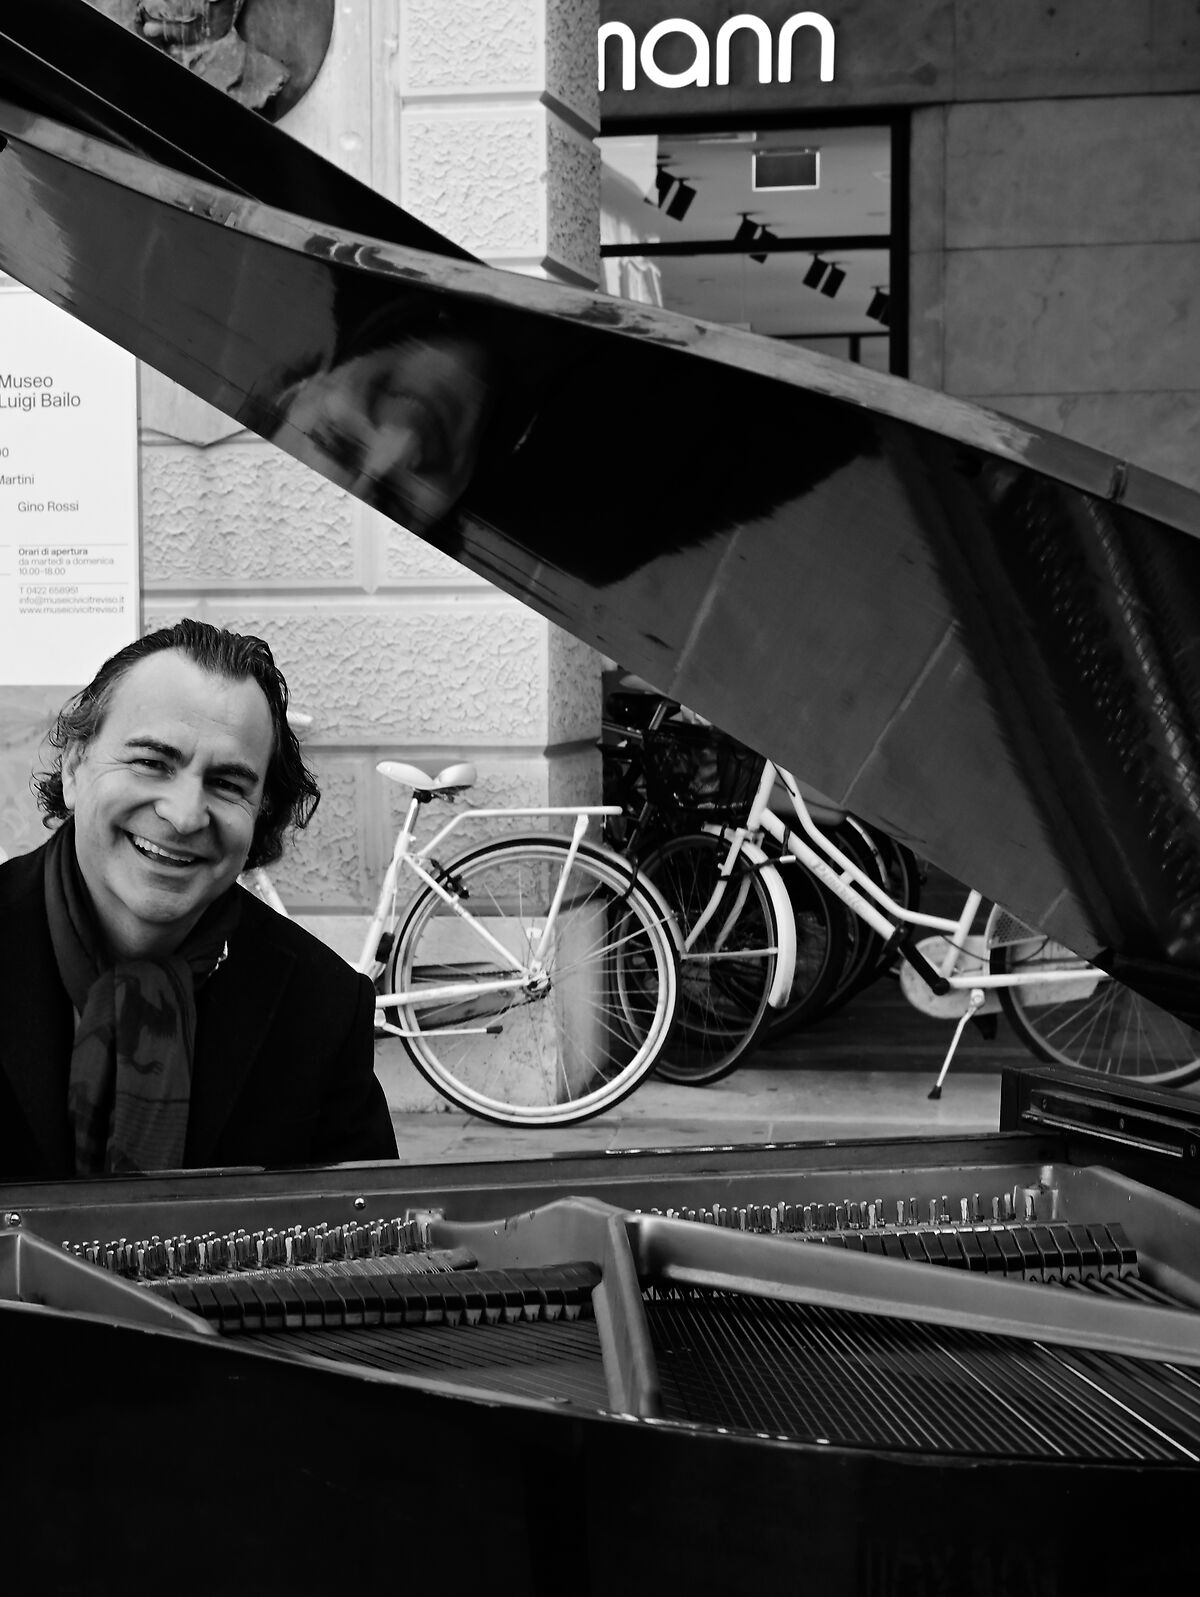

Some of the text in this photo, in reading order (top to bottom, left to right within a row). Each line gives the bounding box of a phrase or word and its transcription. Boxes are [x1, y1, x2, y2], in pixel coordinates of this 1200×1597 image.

[41, 392, 80, 407] Bailo
[18, 501, 79, 512] Gino Rossi
[19, 548, 39, 556] Orari
[51, 548, 88, 557] apertura
[19, 557, 30, 566] da
[73, 557, 114, 565] domenica
